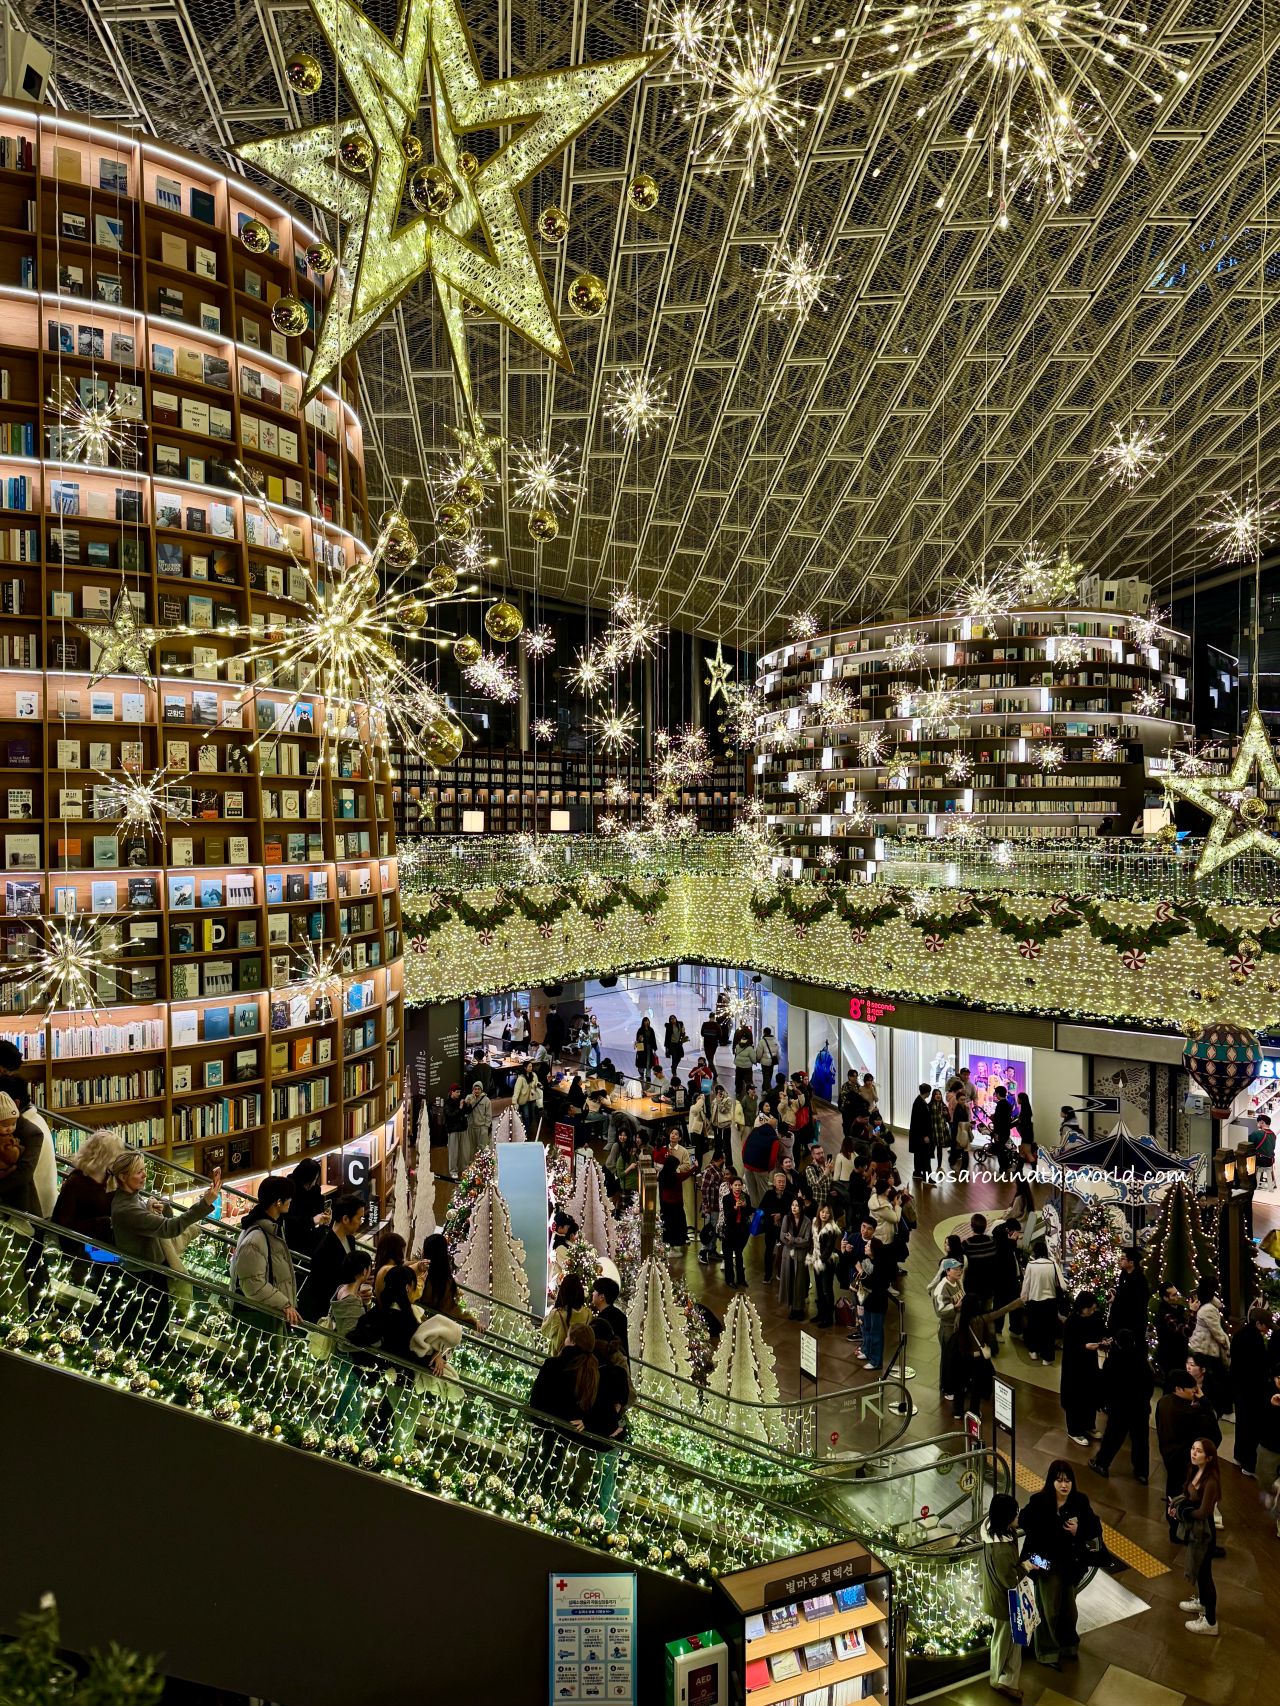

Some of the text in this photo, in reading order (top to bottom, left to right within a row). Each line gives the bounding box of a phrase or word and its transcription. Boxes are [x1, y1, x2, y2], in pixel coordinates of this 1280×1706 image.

[1259, 1060, 1280, 1078] B
[348, 1160, 365, 1186] C
[785, 1563, 854, 1594] 별마당 컬렉션
[583, 1592, 601, 1600] CPR
[695, 1674, 712, 1686] AED
